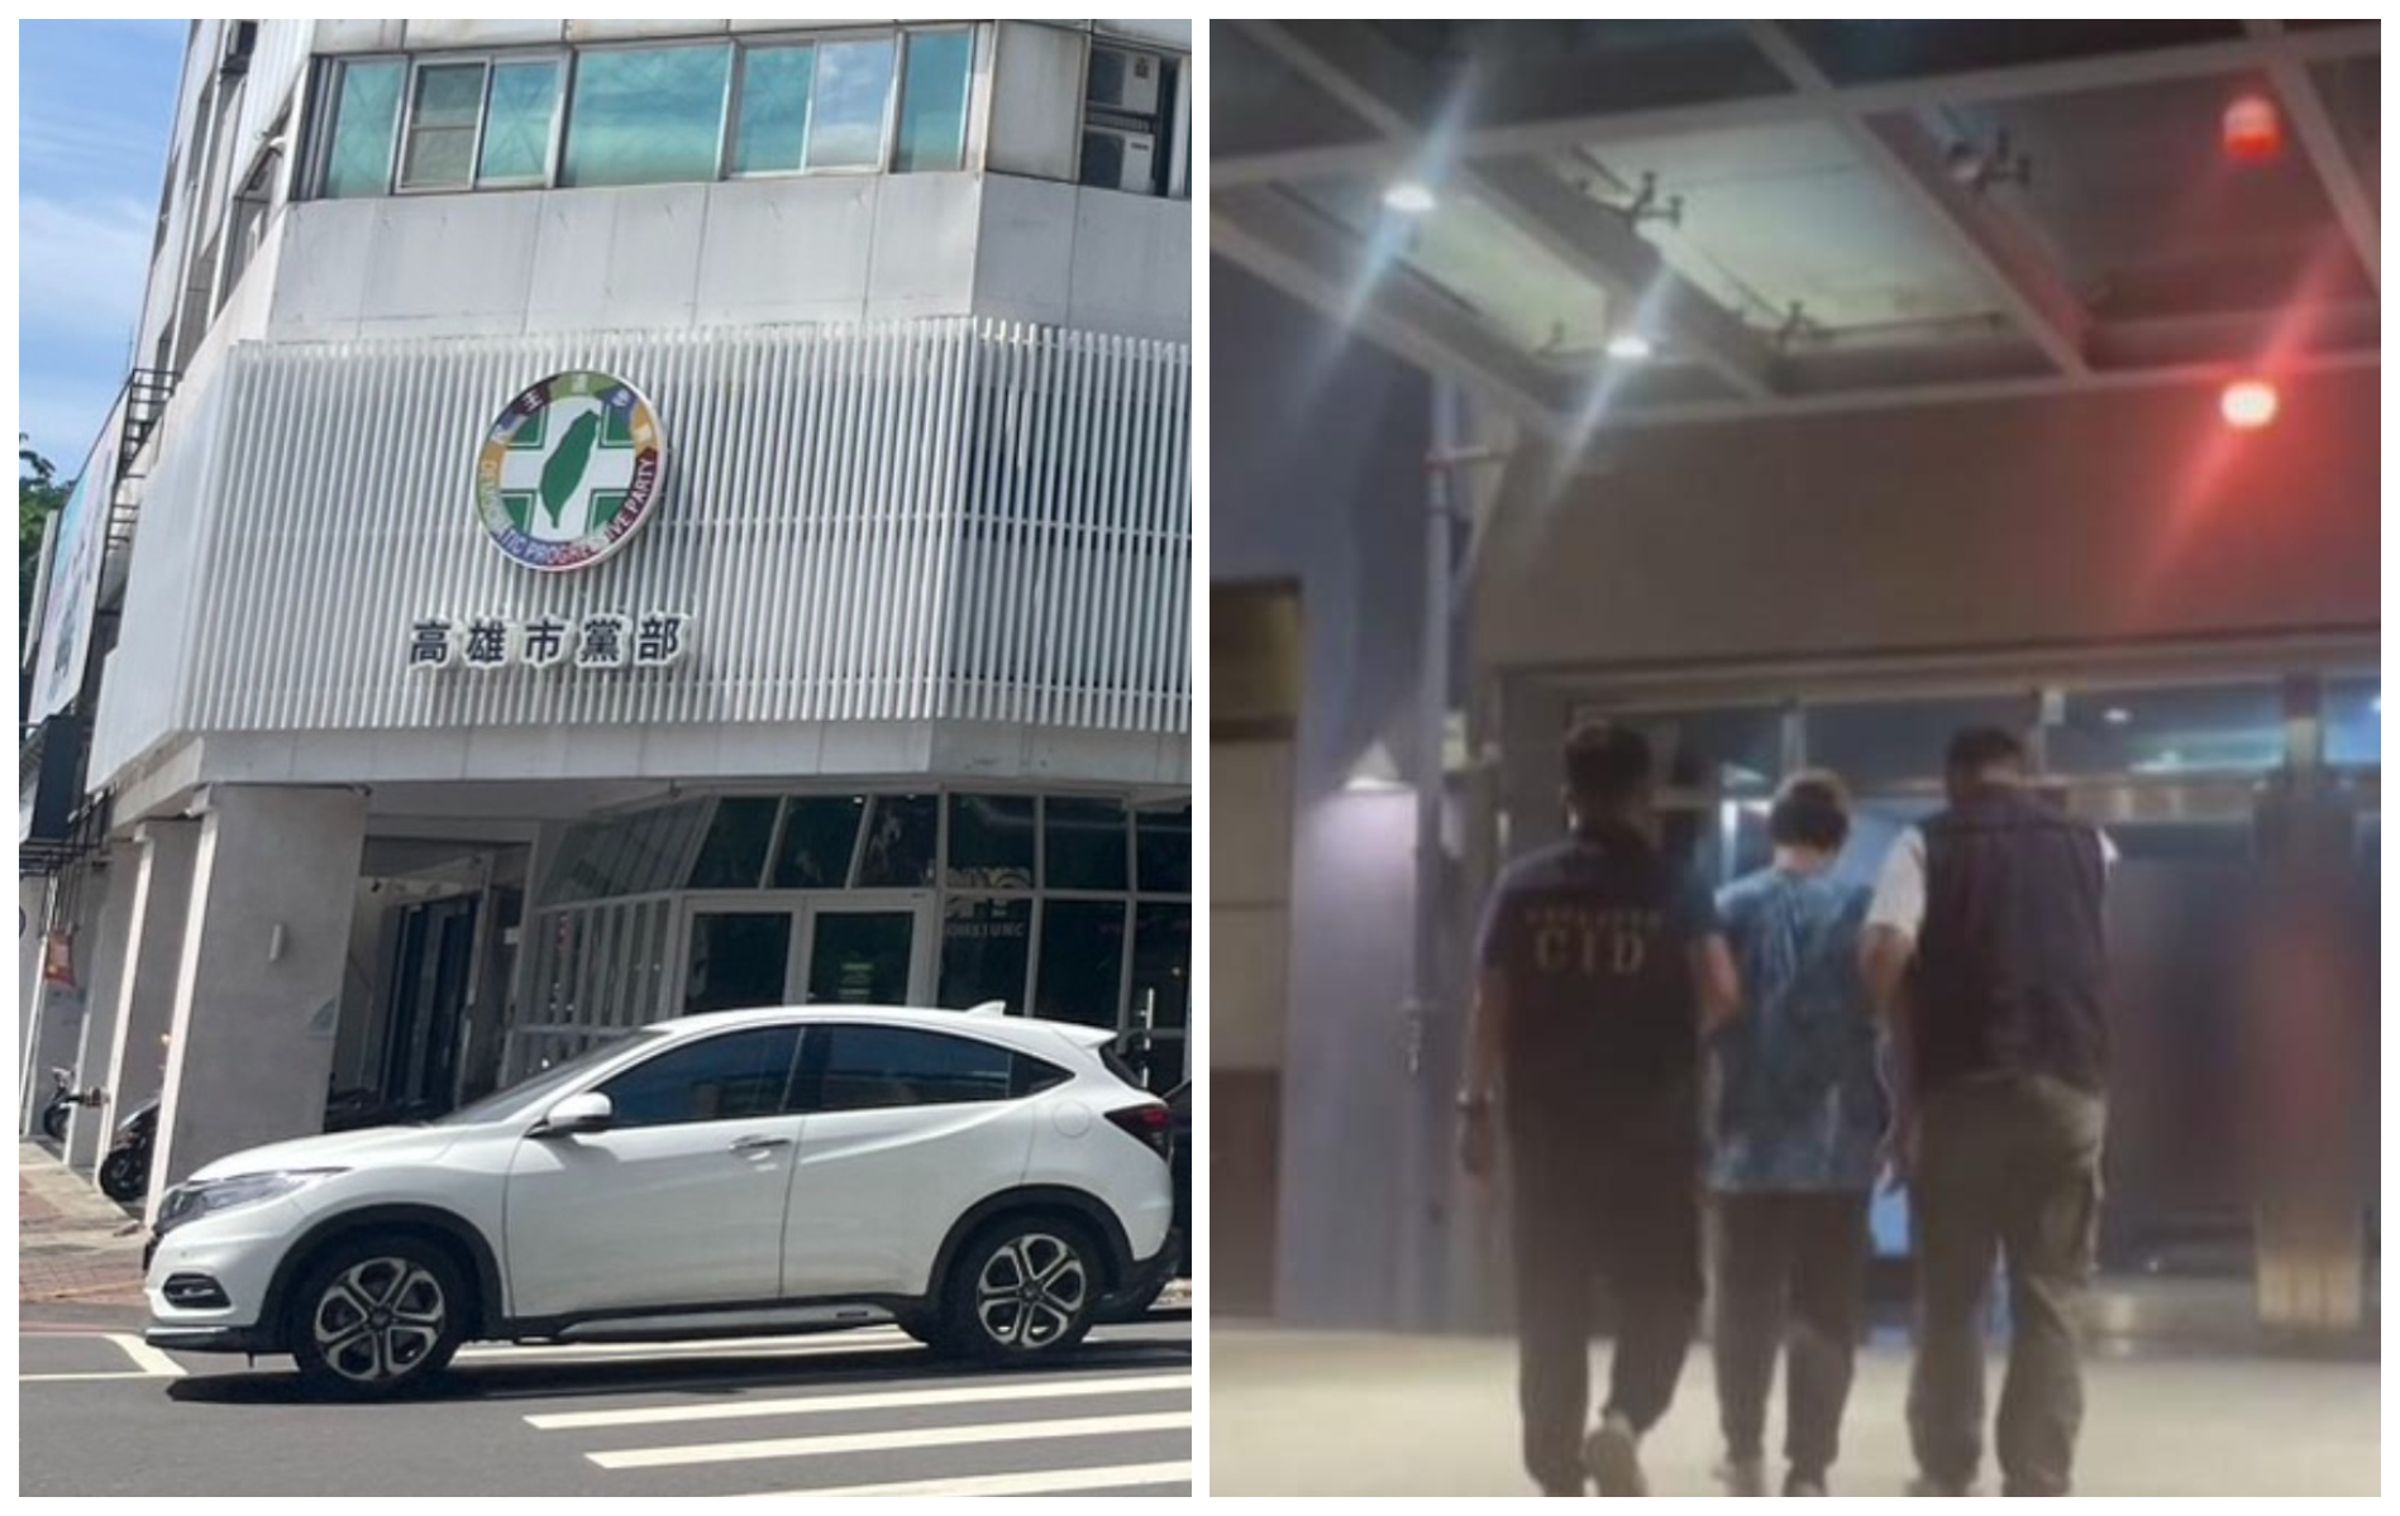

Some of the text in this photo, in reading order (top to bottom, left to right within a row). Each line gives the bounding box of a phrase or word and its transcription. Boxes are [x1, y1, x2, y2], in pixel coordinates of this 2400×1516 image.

[524, 512, 630, 565] PROGREIVE
[629, 457, 655, 513] PARTY
[409, 616, 684, 664] 高雄市黨部
[1535, 928, 1645, 974] CID
